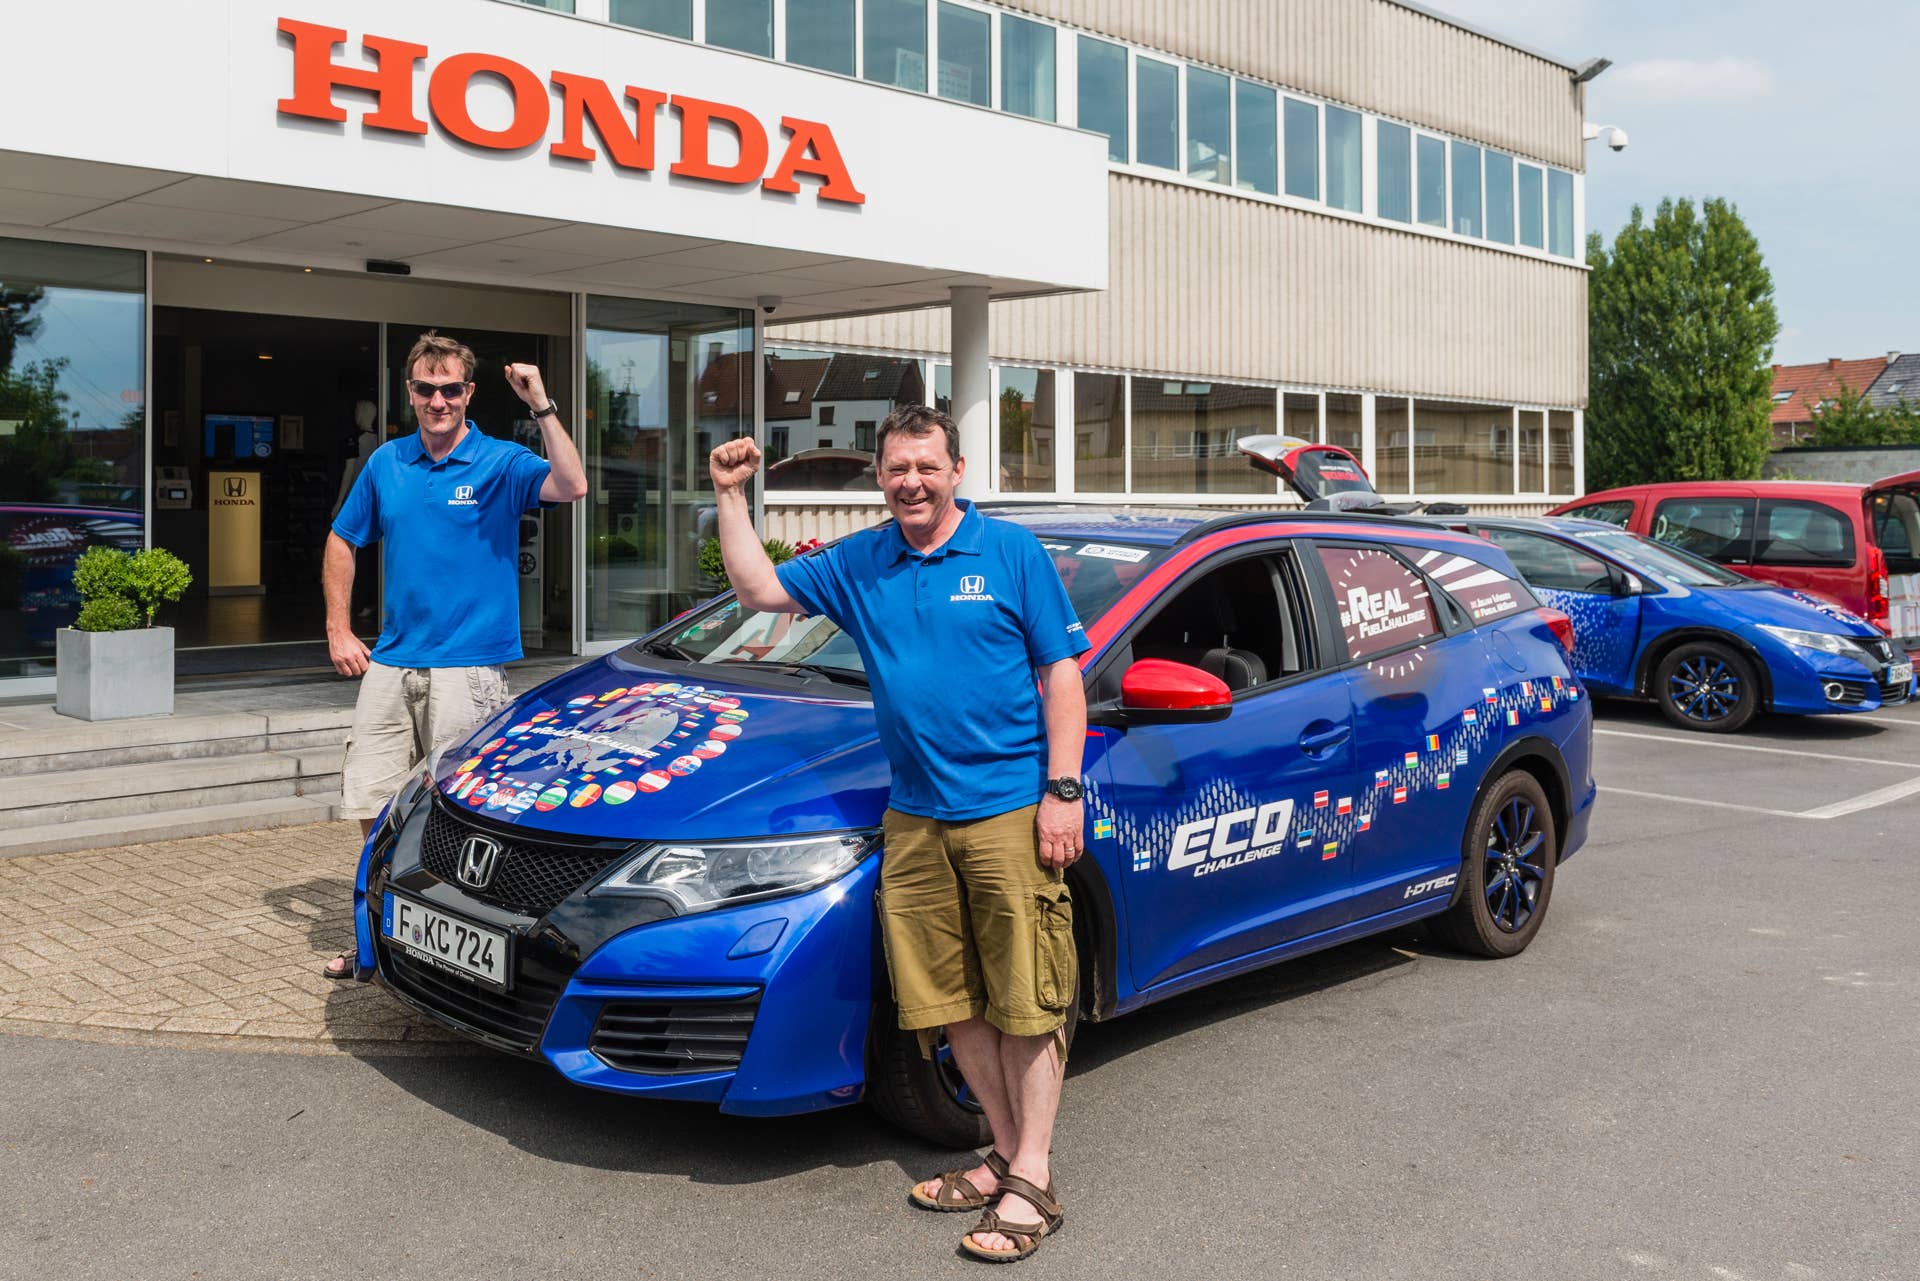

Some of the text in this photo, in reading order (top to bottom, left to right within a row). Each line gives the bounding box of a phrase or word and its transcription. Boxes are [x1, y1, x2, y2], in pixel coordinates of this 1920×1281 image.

[278, 18, 865, 204] HONDA
[213, 499, 256, 507] HONDA
[950, 594, 995, 602] HONDA
[1167, 798, 1295, 872] ECO
[1193, 843, 1283, 878] CHALLENGE
[399, 903, 495, 974] F KC 724
[405, 945, 435, 966] HONDA
